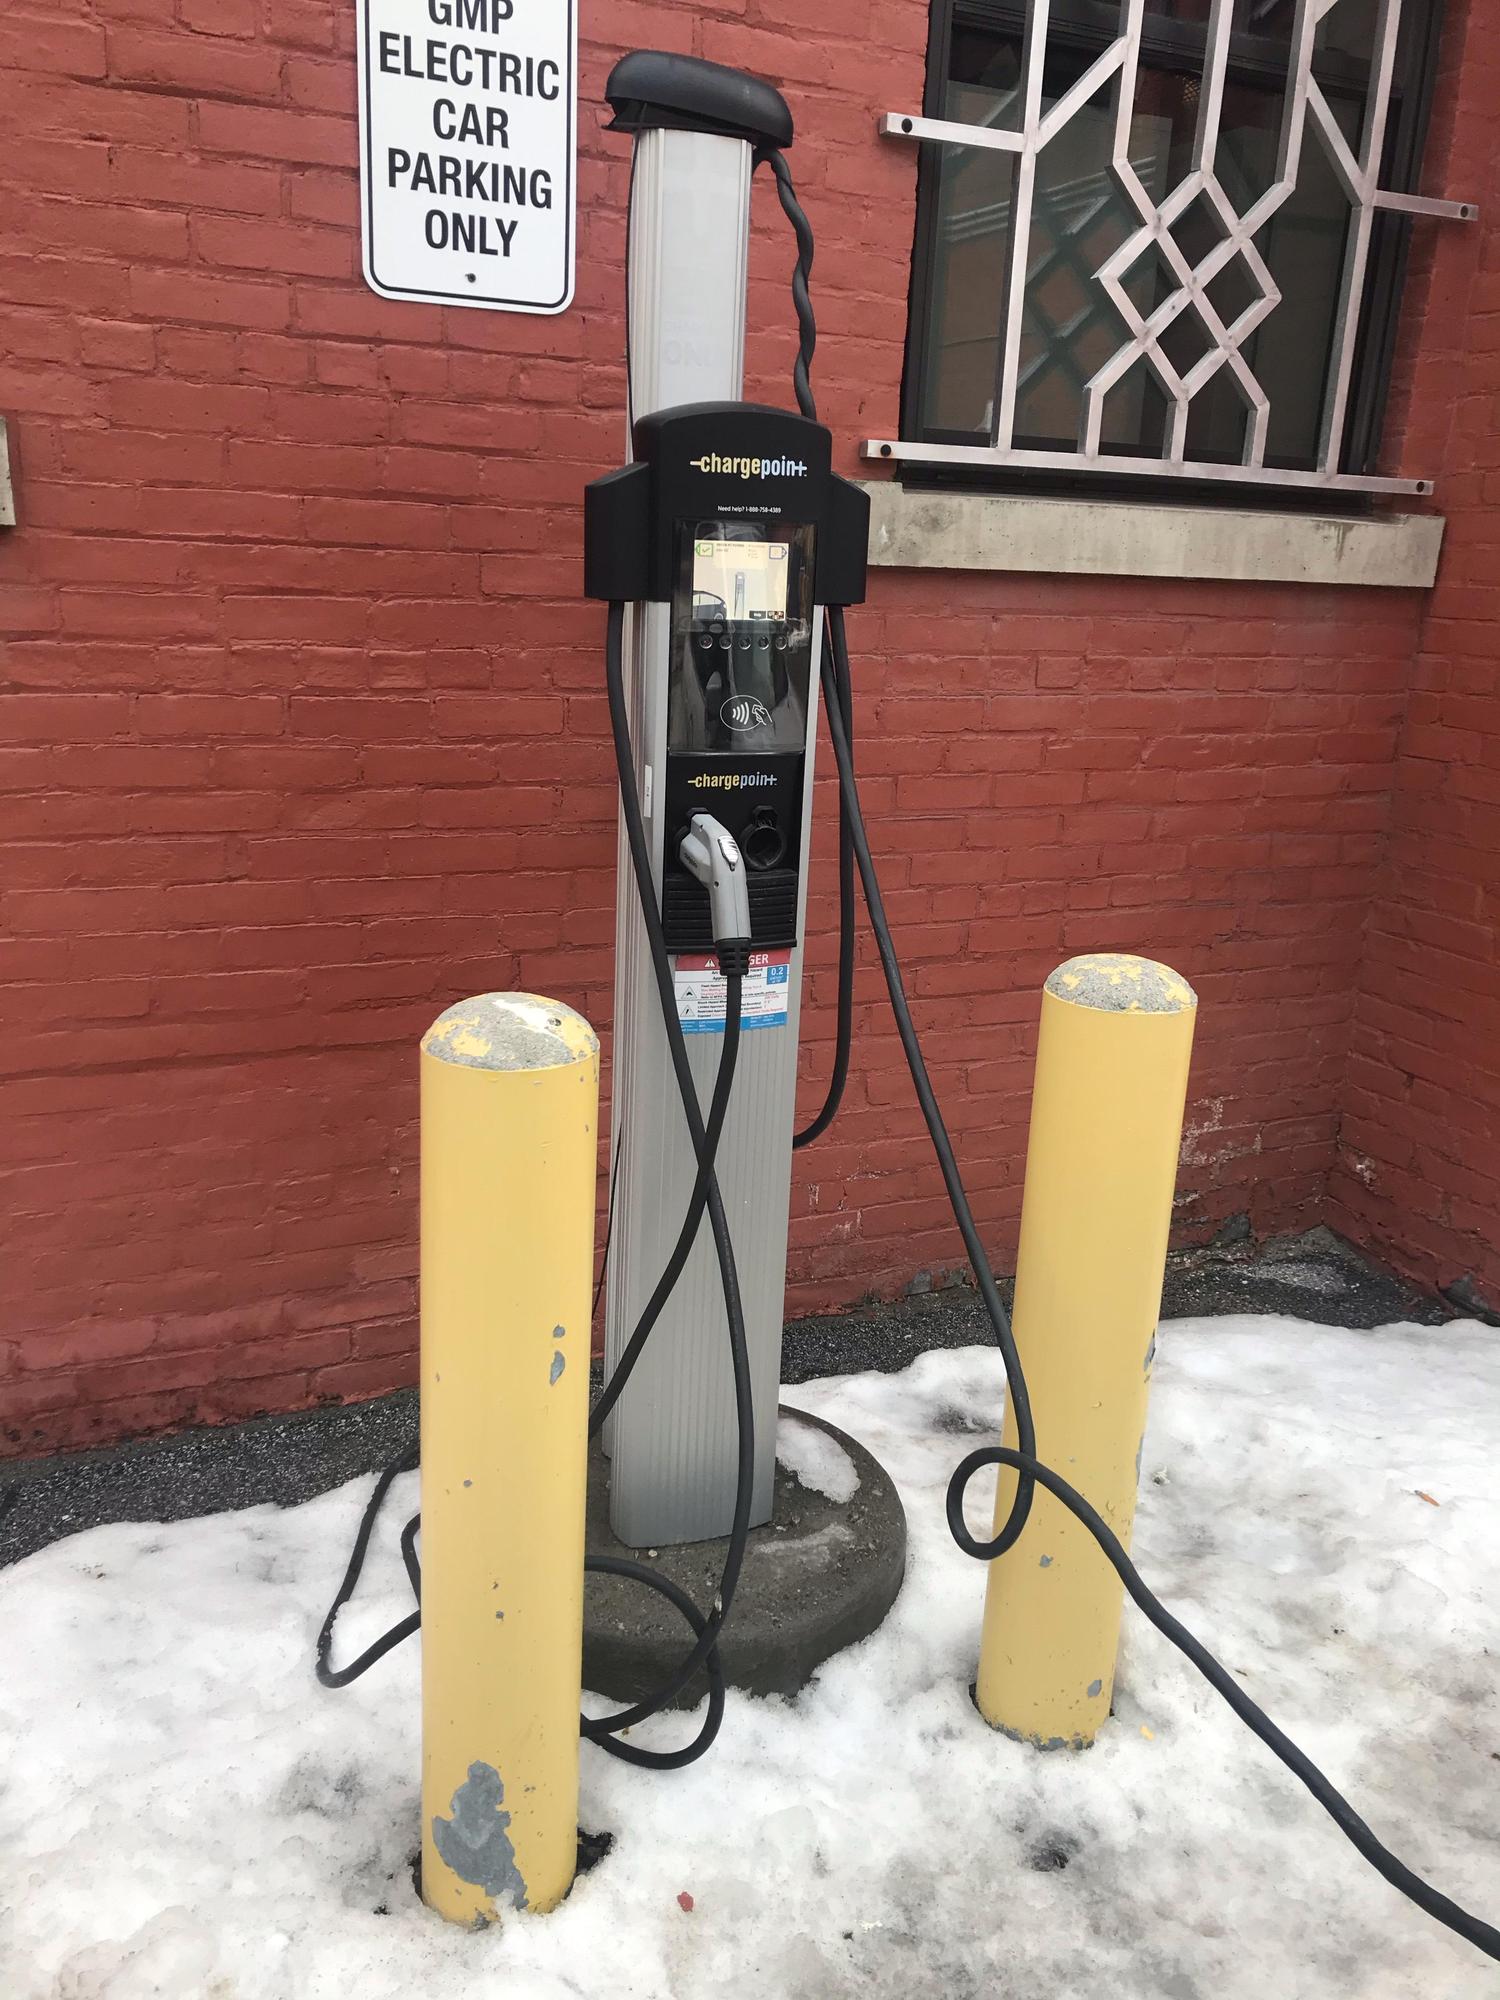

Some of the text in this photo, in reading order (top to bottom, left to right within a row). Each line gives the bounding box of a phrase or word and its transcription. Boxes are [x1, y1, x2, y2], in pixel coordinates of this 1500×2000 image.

[428, 0, 514, 35] GMP
[379, 30, 560, 101] ELECTRIC
[433, 98, 509, 149] CAR
[388, 147, 552, 209] PARKING
[425, 209, 518, 257] ONLY
[731, 505, 745, 513] help?
[770, 966, 784, 977] 0.2
